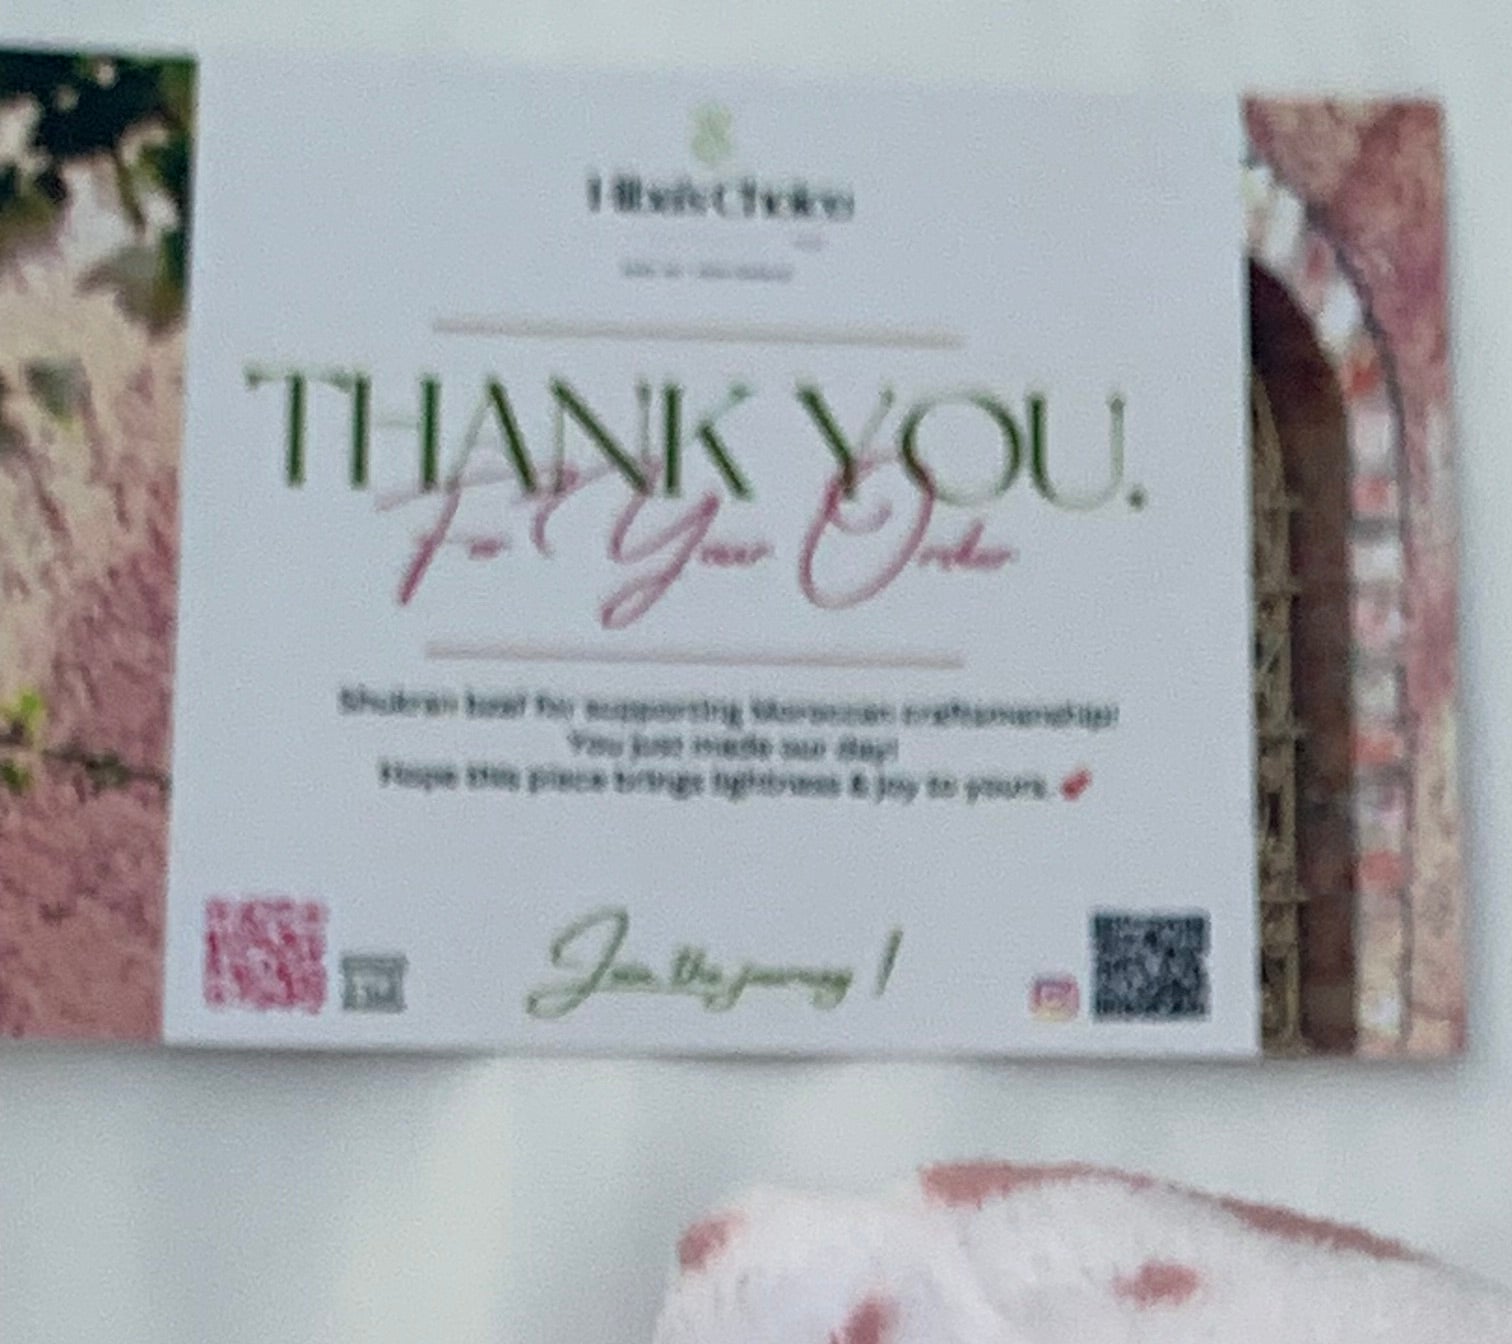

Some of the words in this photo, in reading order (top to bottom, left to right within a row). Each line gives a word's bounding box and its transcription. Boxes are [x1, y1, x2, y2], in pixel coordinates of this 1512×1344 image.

[243, 358, 755, 501] THANK
[797, 376, 1149, 513] YOU.
[375, 464, 560, 606] For
[530, 452, 775, 632] Your
[798, 448, 1017, 611] Order
[338, 684, 459, 718] Shukran
[533, 689, 575, 721] for
[583, 695, 746, 730] supporting
[749, 695, 896, 726] Moroccan
[903, 698, 1121, 732] craftsmanship!
[566, 729, 623, 757] You
[628, 732, 684, 761] just
[693, 735, 773, 761] made
[780, 737, 827, 761] our
[836, 734, 899, 766] day!
[377, 758, 458, 793] Hope
[465, 761, 521, 791] this
[527, 764, 606, 795] piece
[612, 767, 704, 800] brings
[711, 770, 842, 804] lightness
[850, 772, 869, 799] &
[875, 773, 920, 804] joy
[926, 775, 958, 800] to
[526, 905, 656, 1020] Join
[671, 940, 724, 986] the
[702, 957, 854, 1012] journey
